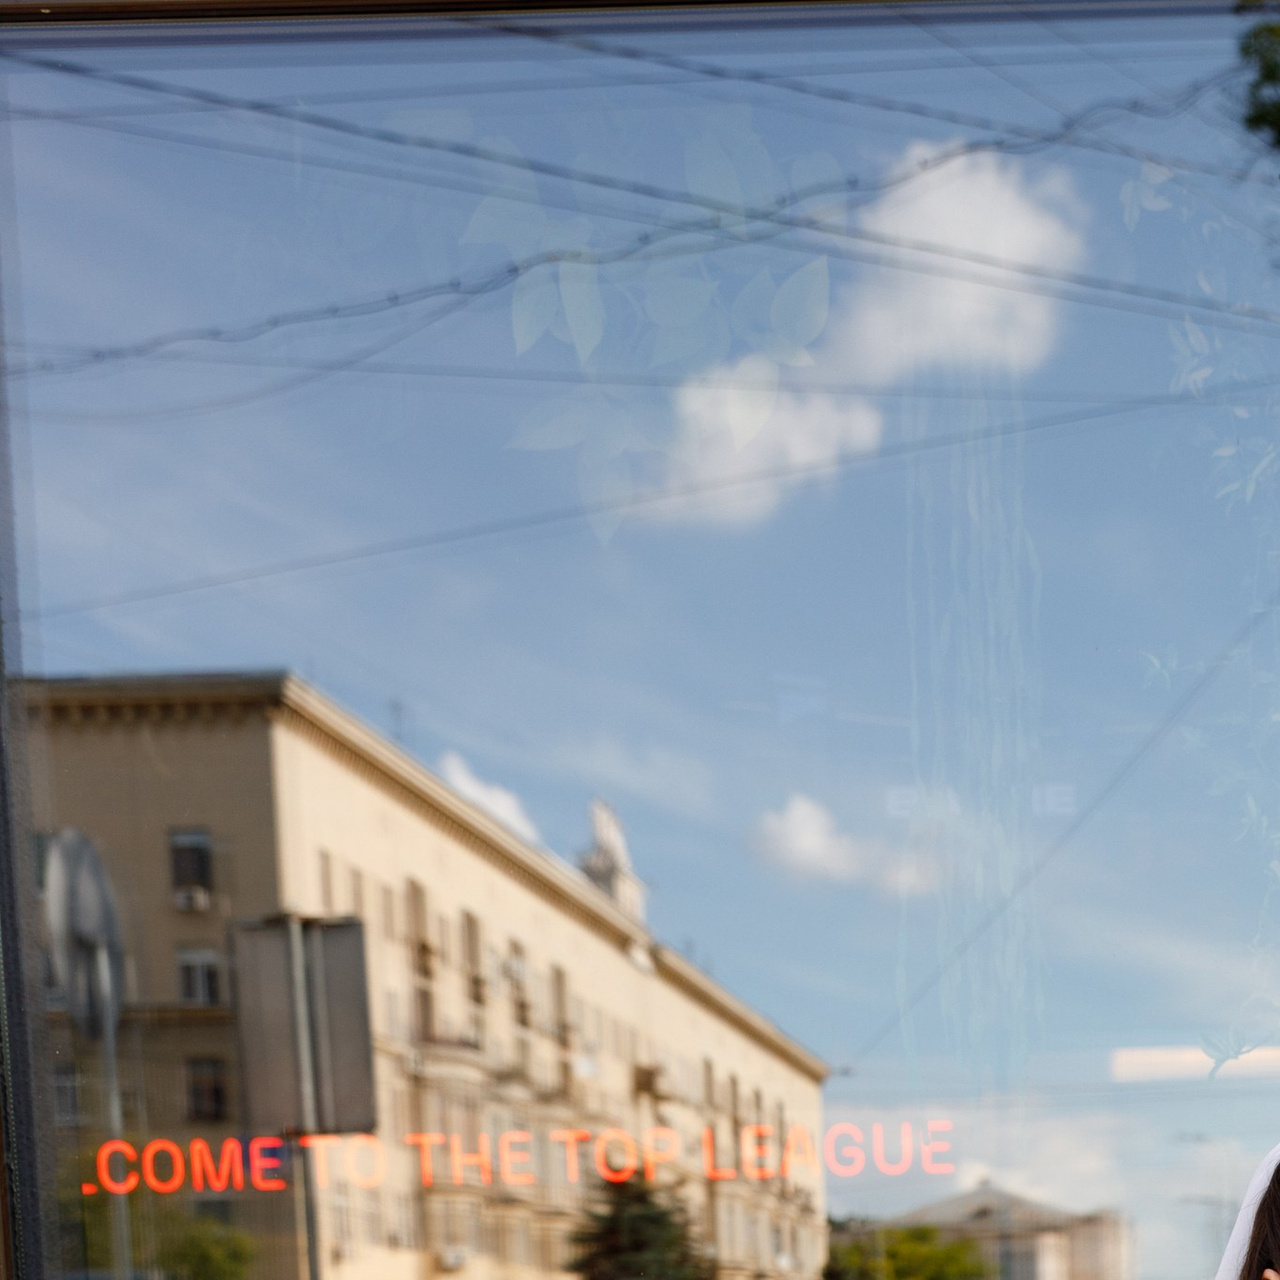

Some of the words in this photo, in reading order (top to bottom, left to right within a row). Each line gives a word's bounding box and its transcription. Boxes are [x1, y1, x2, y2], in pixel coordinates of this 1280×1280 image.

[82, 1136, 287, 1195] COME
[299, 1134, 386, 1187] TO
[406, 1131, 534, 1186] THE
[549, 1129, 680, 1183] TOP
[702, 1120, 955, 1181] LEAGUE
